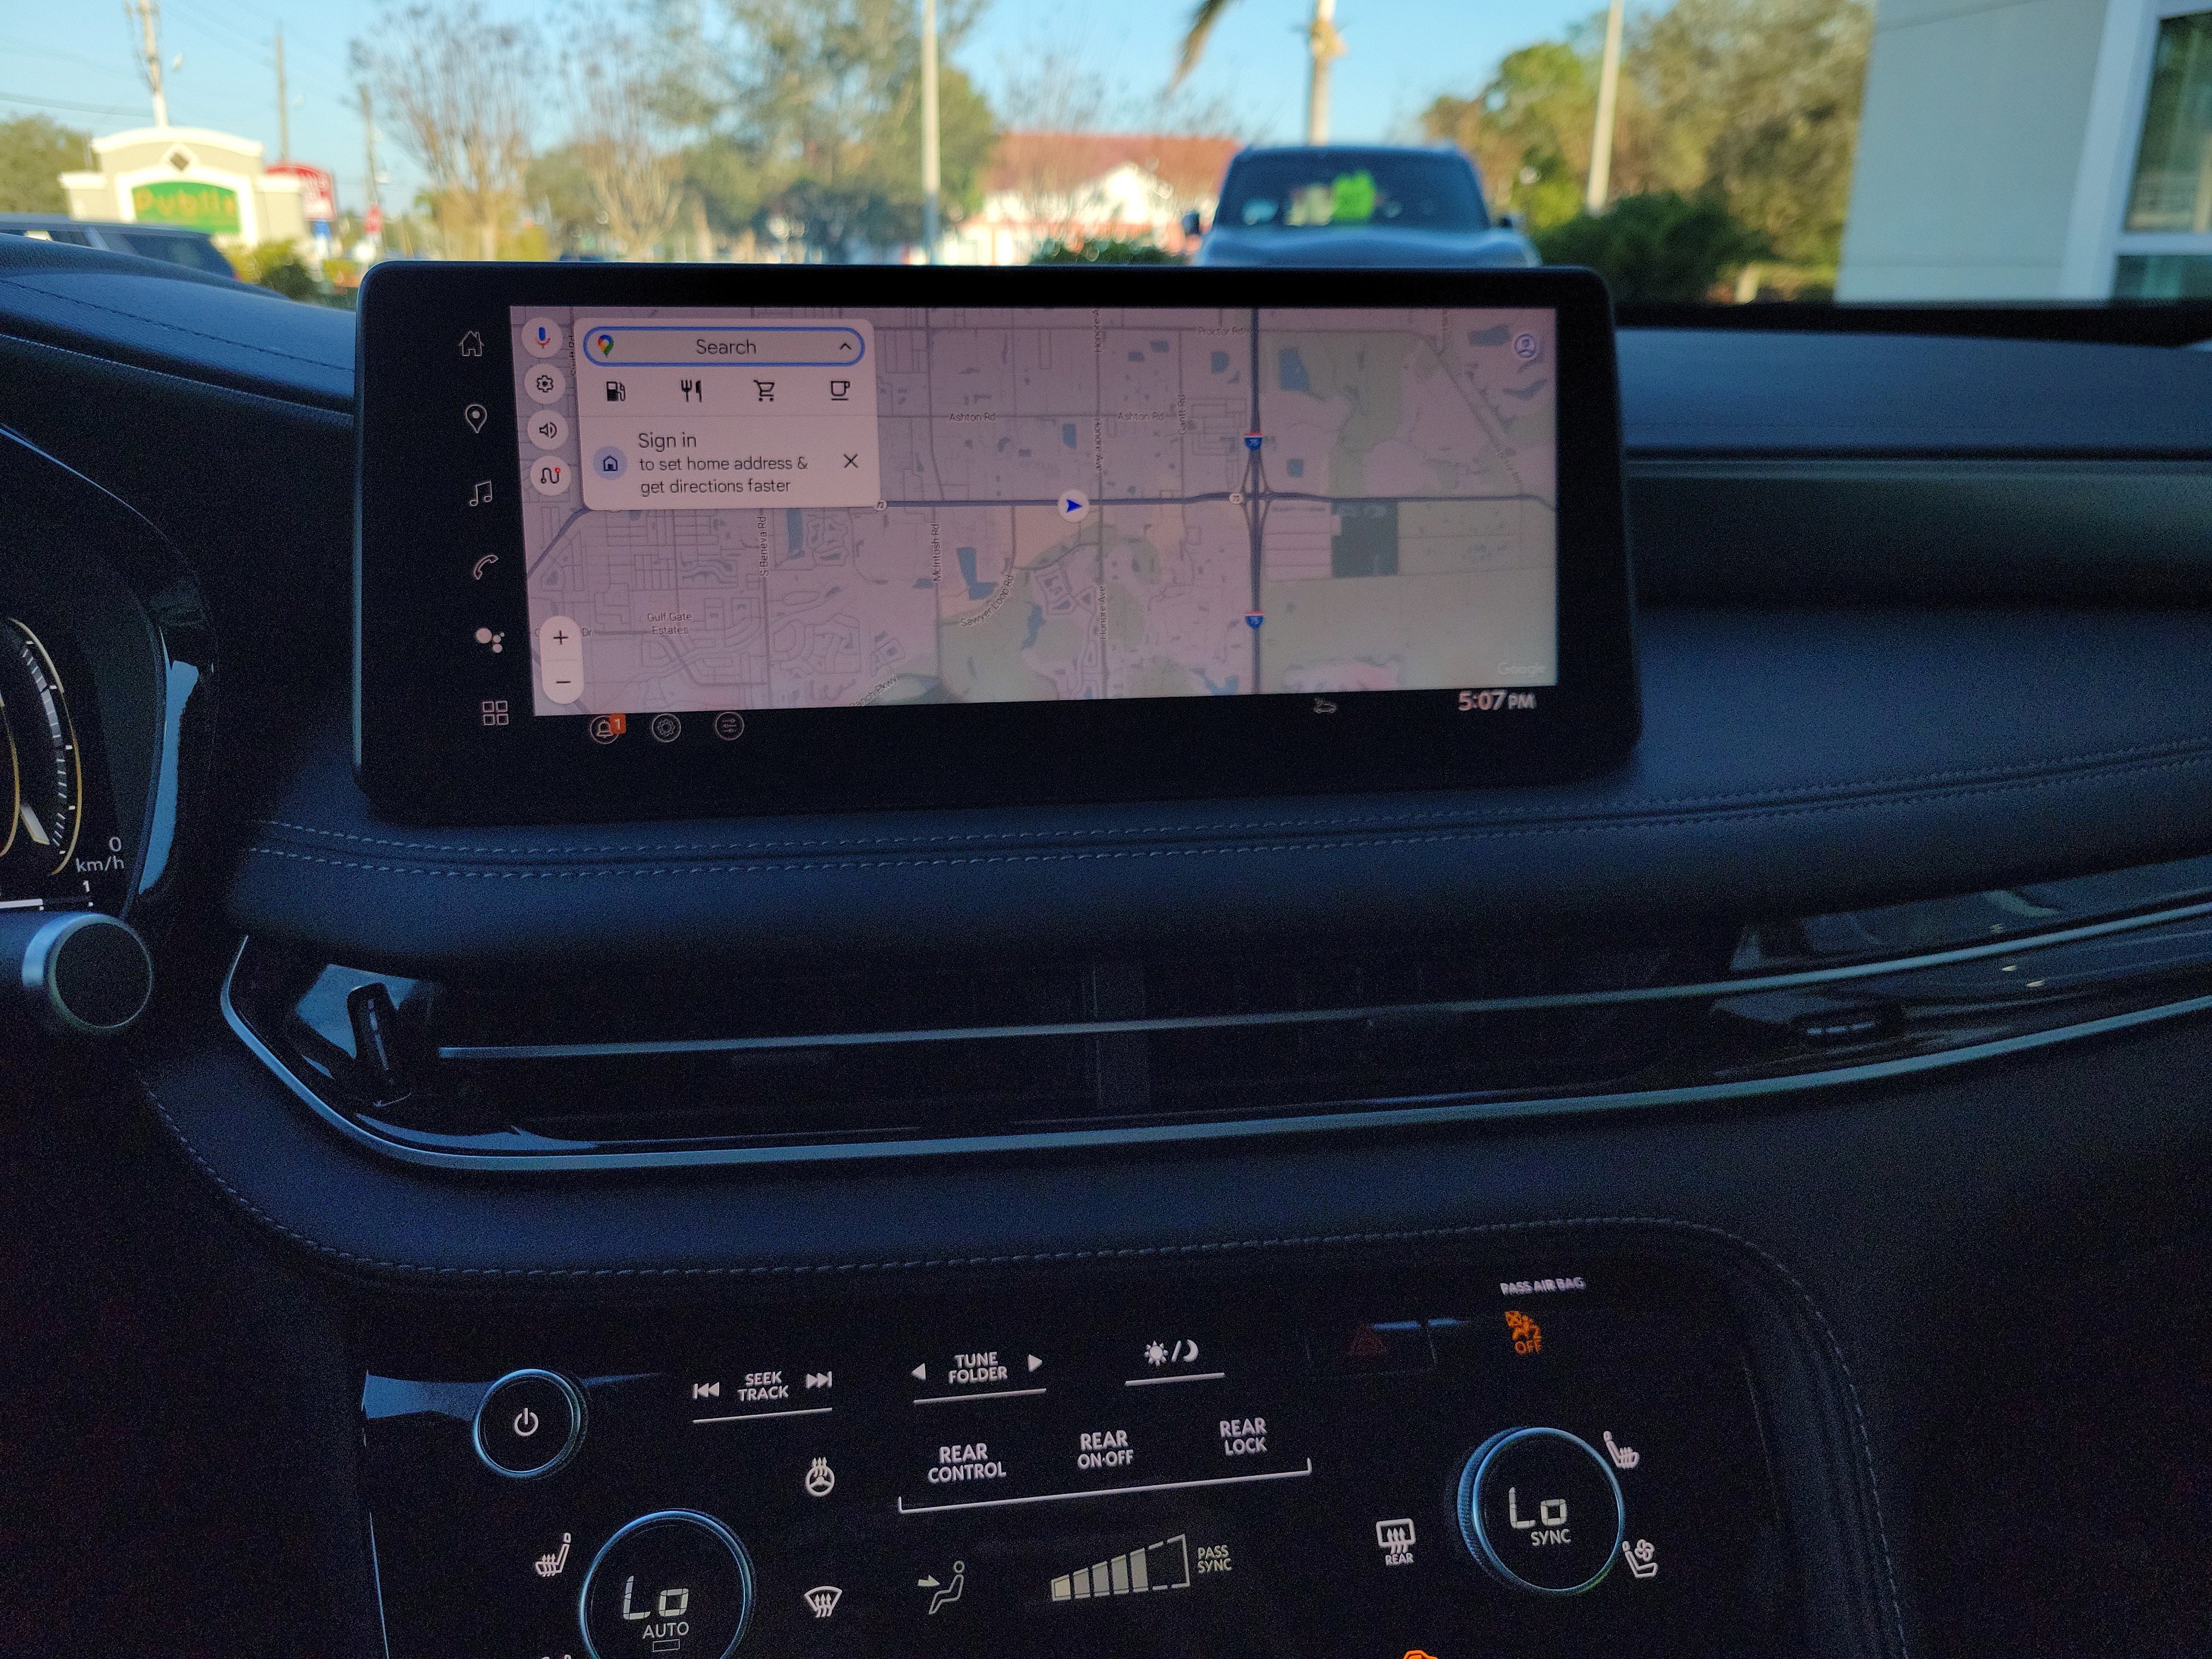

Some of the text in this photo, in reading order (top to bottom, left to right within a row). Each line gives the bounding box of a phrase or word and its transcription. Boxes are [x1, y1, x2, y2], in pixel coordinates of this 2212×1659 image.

[696, 339, 757, 355] Search
[949, 412, 996, 421] Ashton Rd
[1117, 411, 1164, 421] Ashton Rd
[639, 432, 696, 452] Sign in
[640, 456, 808, 470] to set home address &
[641, 478, 791, 496] get directions faster
[757, 516, 766, 529] Rd
[759, 531, 769, 568] Beneva
[930, 523, 941, 582] McIntosh Rd
[960, 574, 1014, 627] Sawyer Loop Rd
[1098, 585, 1106, 602] Ave
[647, 612, 692, 622] Gulf Gate
[582, 628, 592, 637] Dr
[652, 627, 690, 635] Estates
[1458, 690, 1536, 711] 5:07 PM
[109, 836, 122, 852] 0
[75, 855, 125, 872] km/h
[83, 879, 90, 893] 1
[1500, 1277, 1587, 1295] PASS AIR BAG
[955, 1352, 998, 1367] TUNE
[745, 1372, 782, 1386] SEEK
[949, 1366, 1008, 1383] FOLDER
[738, 1385, 789, 1401] TRACK
[1220, 1417, 1267, 1437] REAR
[1080, 1430, 1128, 1451] REAR
[1224, 1437, 1267, 1456] LOCK
[940, 1443, 988, 1463] REAR
[928, 1462, 1007, 1482] CONTROL
[1509, 1487, 1567, 1528] Lo
[1531, 1528, 1572, 1545] SYNC
[1198, 1544, 1229, 1559] PASS
[1385, 1553, 1414, 1566] REAR
[1197, 1558, 1232, 1573] SYNC
[623, 1575, 689, 1620] Lo
[642, 1621, 690, 1640] AUTO
